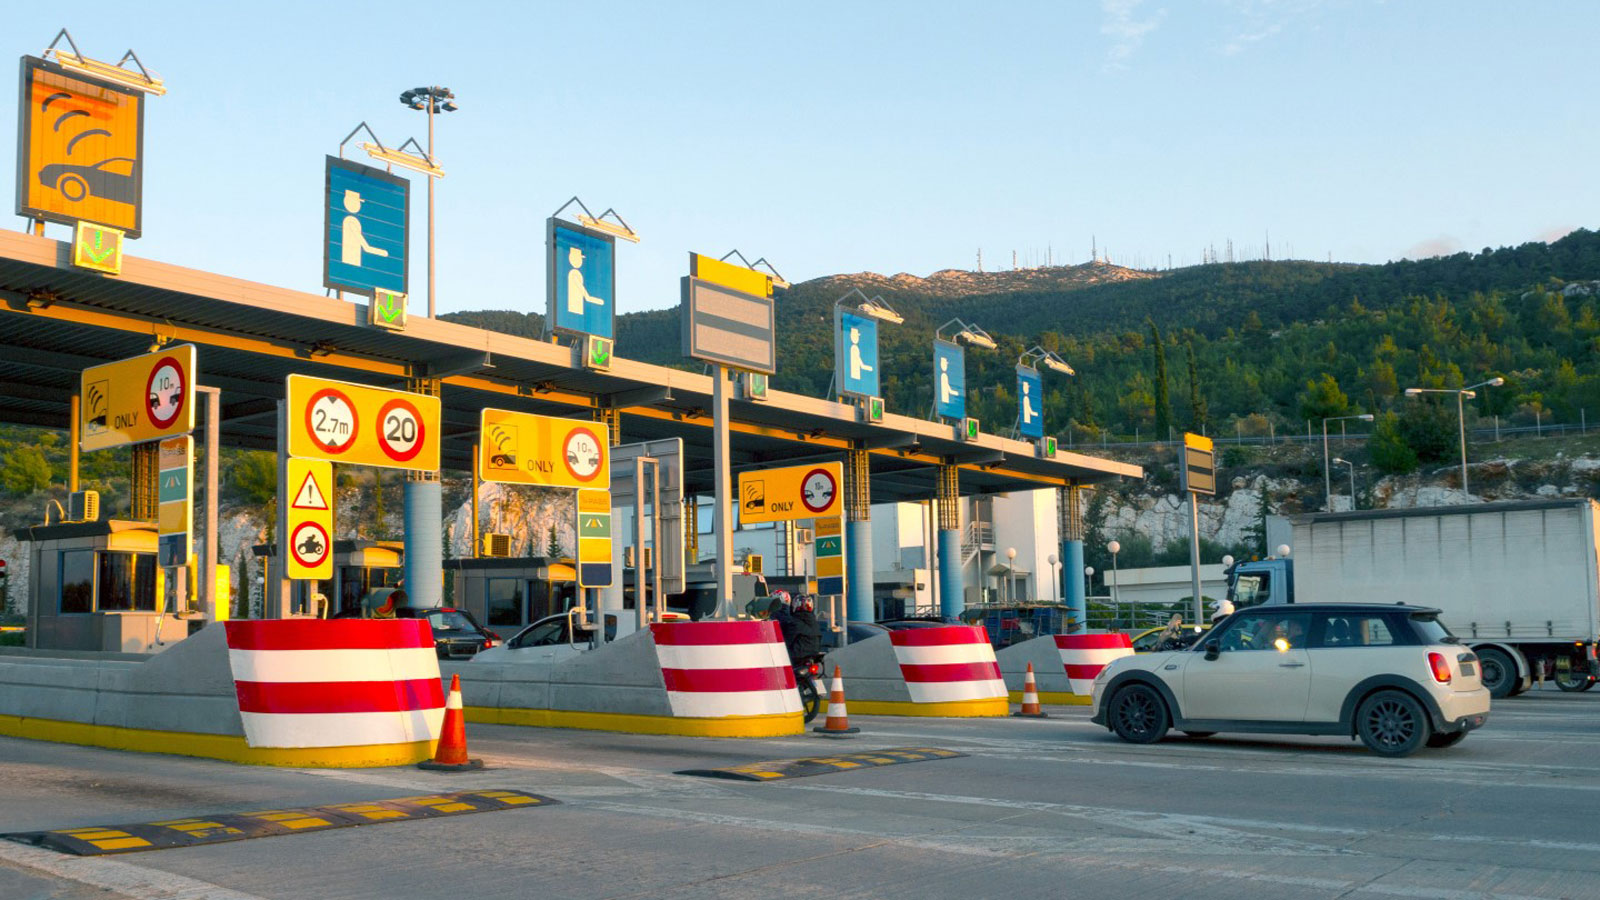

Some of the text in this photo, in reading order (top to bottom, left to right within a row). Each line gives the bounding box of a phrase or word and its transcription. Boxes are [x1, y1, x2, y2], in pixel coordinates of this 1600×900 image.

[114, 411, 139, 429] ONLY
[315, 408, 349, 435] 2.7m
[387, 415, 416, 443] 20
[527, 459, 555, 473] ONLY
[770, 501, 794, 513] ONLY
